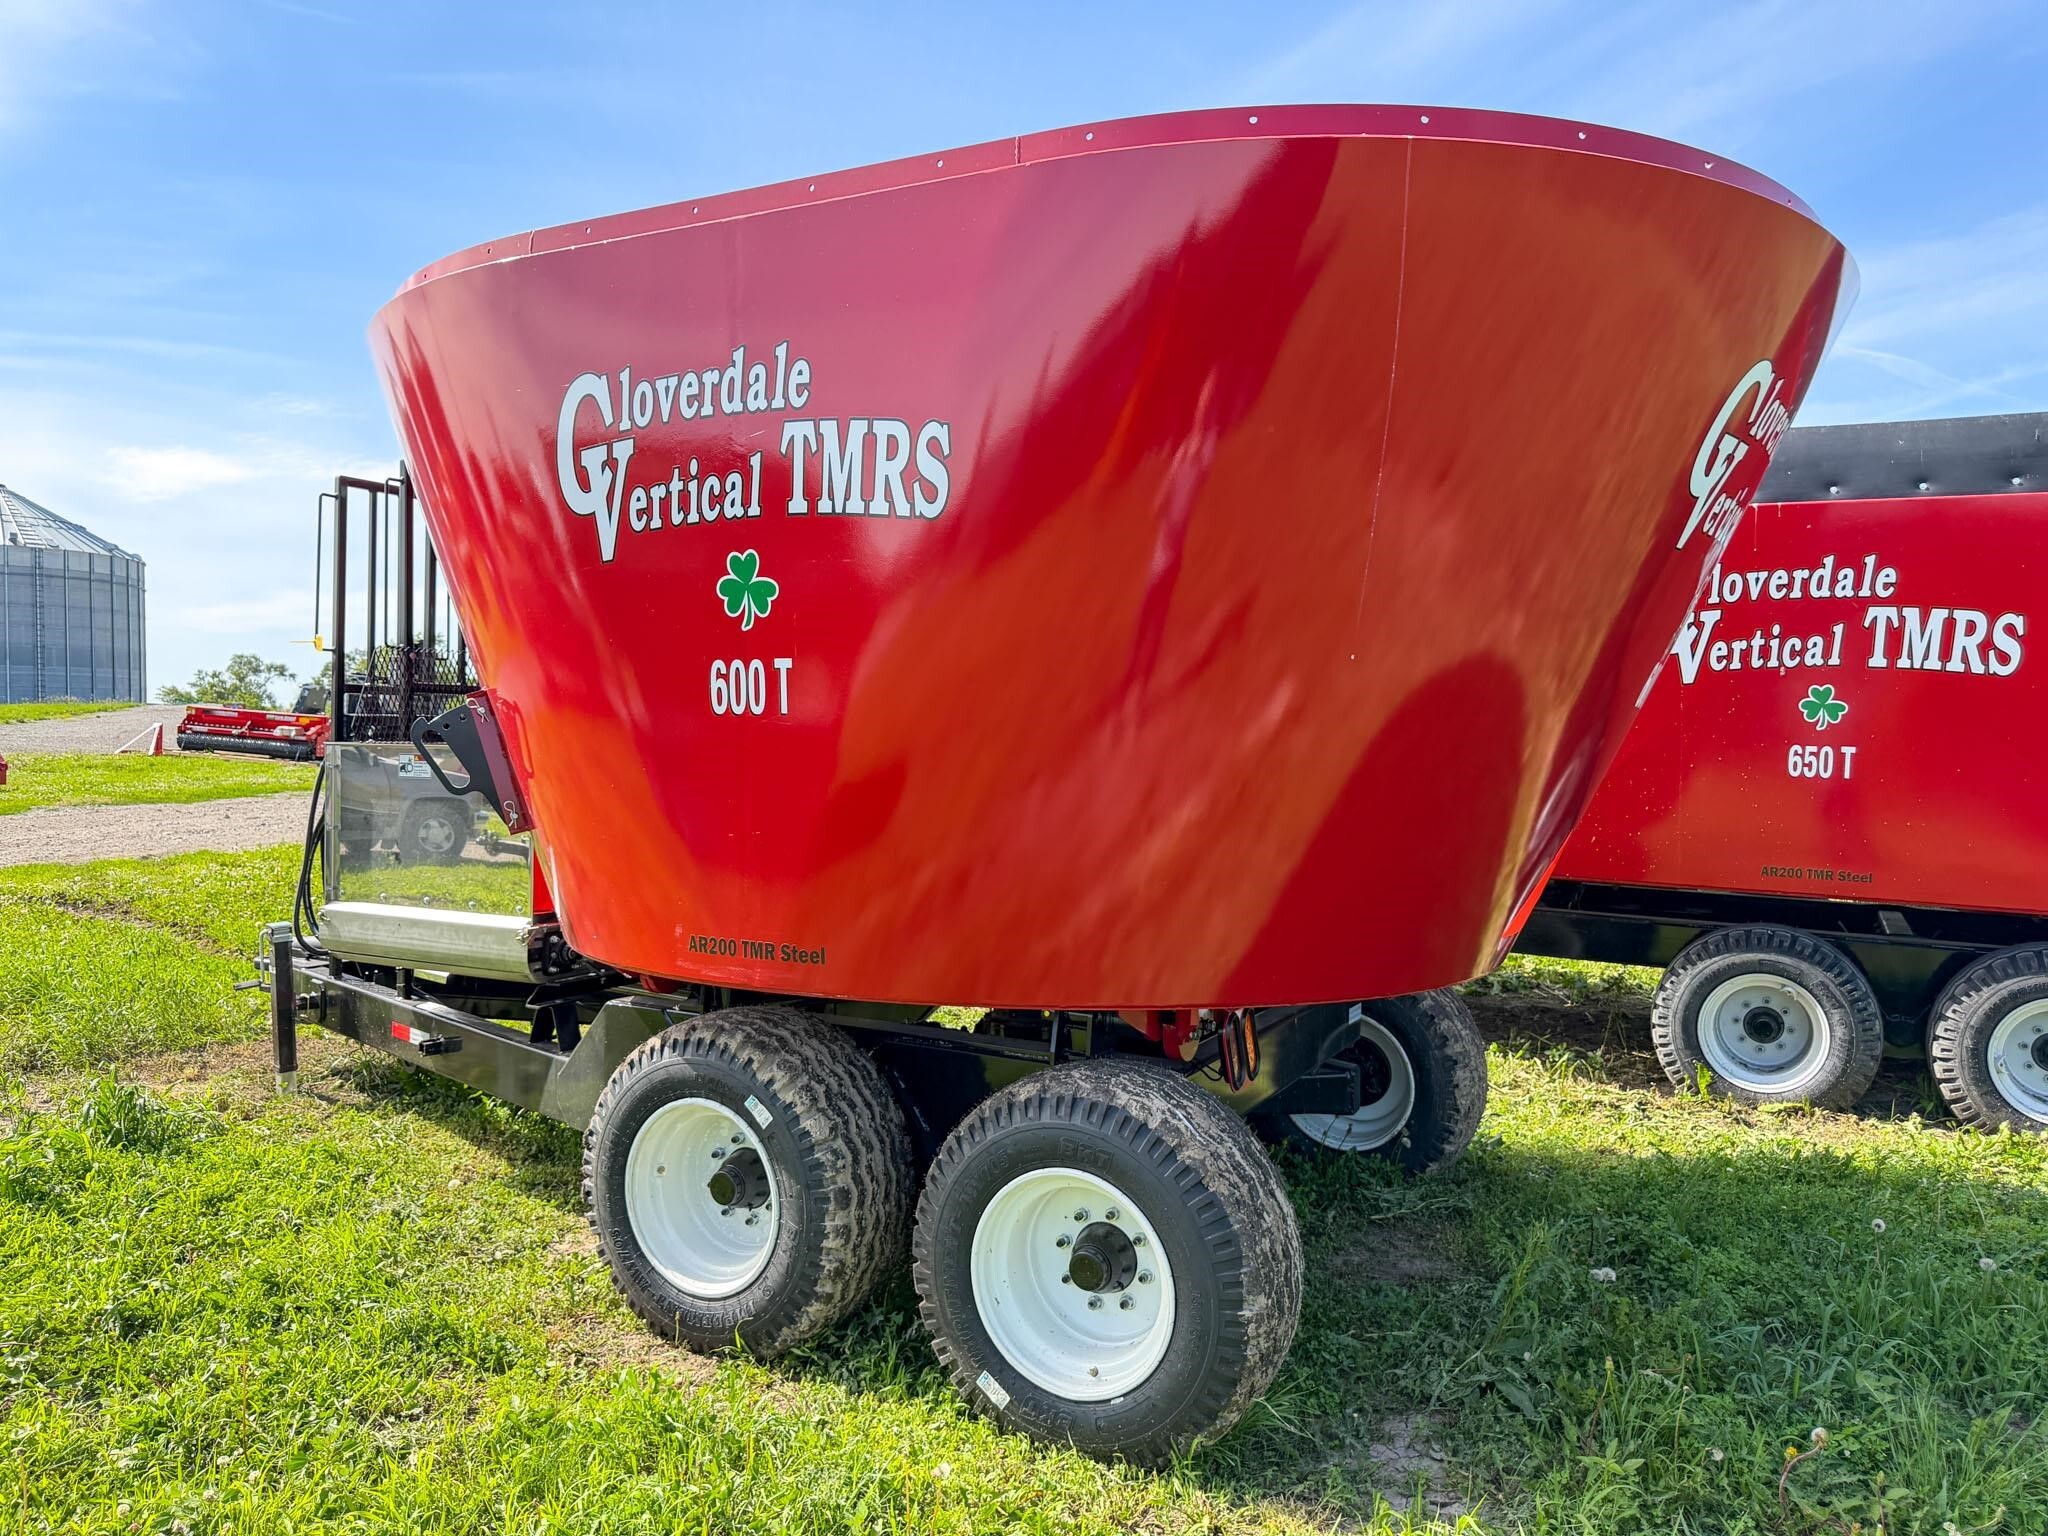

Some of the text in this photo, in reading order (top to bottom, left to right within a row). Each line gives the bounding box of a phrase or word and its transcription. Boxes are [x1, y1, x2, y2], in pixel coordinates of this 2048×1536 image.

[556, 340, 811, 517] Cloverdale
[580, 416, 951, 564] Vertical TMRS
[1707, 553, 1898, 605] loverdale
[1674, 608, 1845, 685] Vertical
[1861, 604, 2025, 677] TMRS
[709, 656, 793, 717] 600 T
[1786, 744, 1857, 780] 650 T
[1761, 866, 1873, 883] AR200 TMR Steel
[688, 934, 826, 965] AR200 TMR Steel
